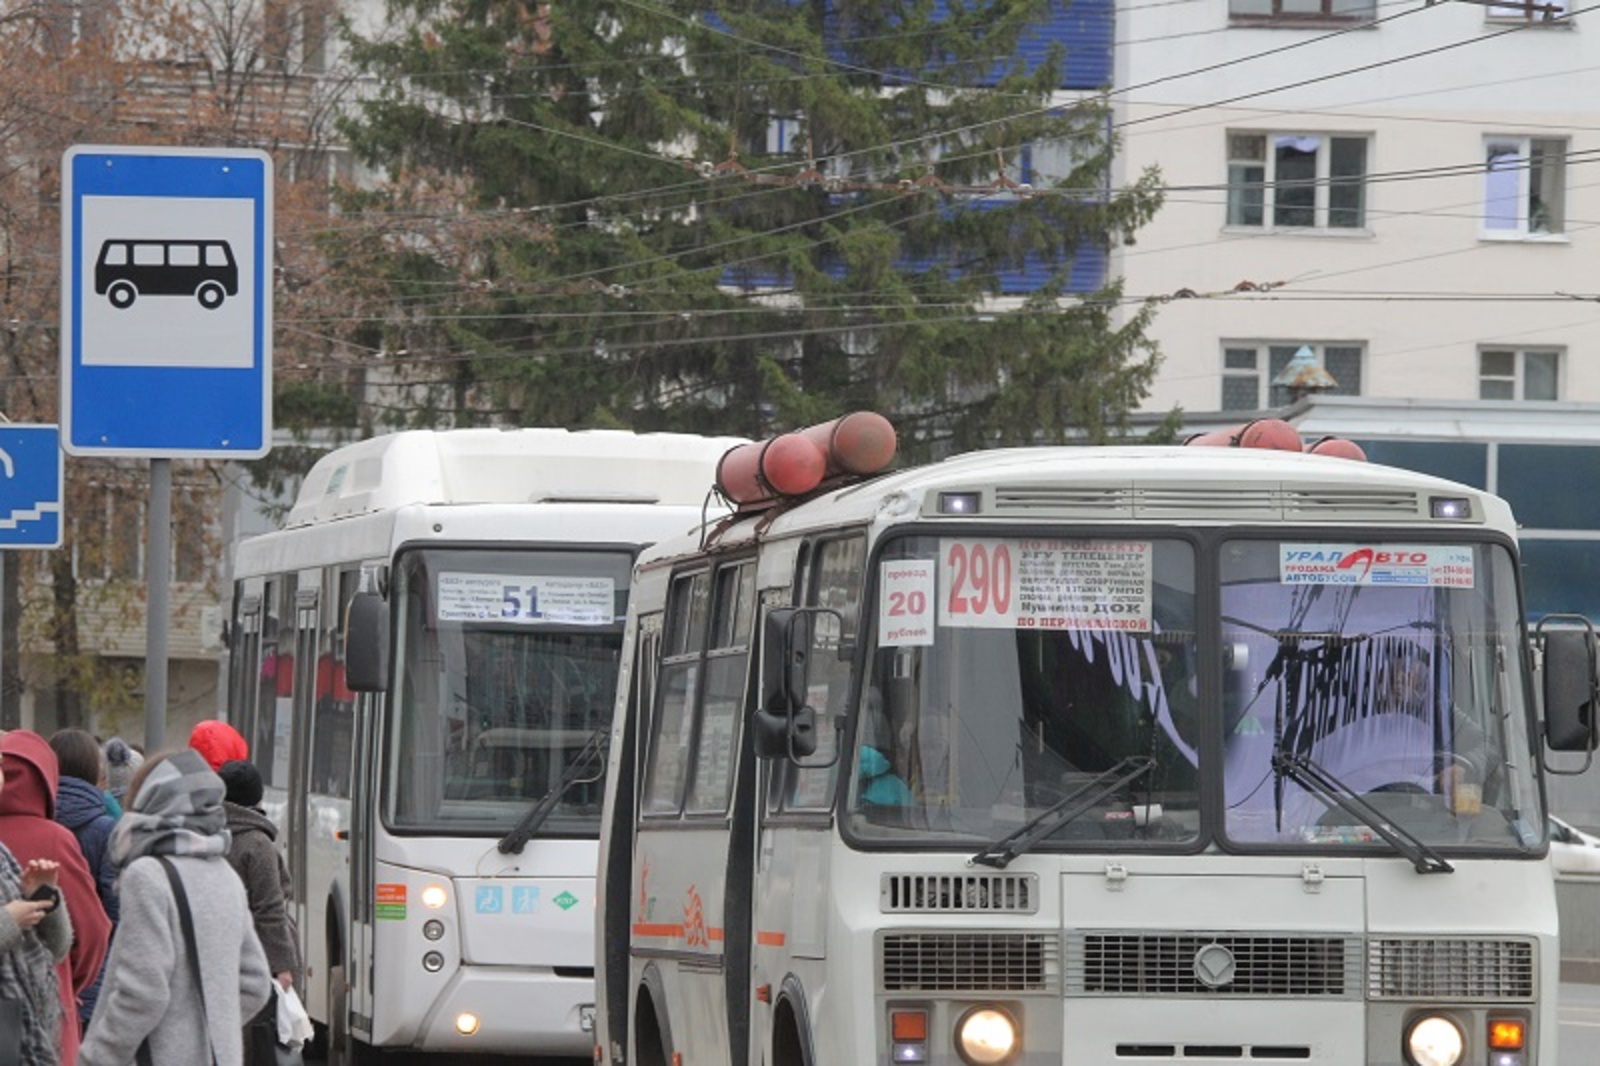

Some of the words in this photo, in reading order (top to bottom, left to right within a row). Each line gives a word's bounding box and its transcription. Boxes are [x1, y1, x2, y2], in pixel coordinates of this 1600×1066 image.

[1061, 551, 1143, 560] ТЕЛЕЦЕНТР
[1286, 551, 1343, 562] УРАЛ
[887, 569, 928, 580] проезд
[1285, 565, 1336, 573] ПРОДАЖА
[948, 543, 1011, 615] 290
[1286, 574, 1357, 583] АВТОБУСОВ
[1107, 587, 1145, 595] УМПО
[502, 586, 543, 617] 51
[888, 591, 927, 617] 20
[1093, 603, 1142, 615] ДОК
[1017, 617, 1035, 627] ПО
[887, 627, 927, 640] рублей
